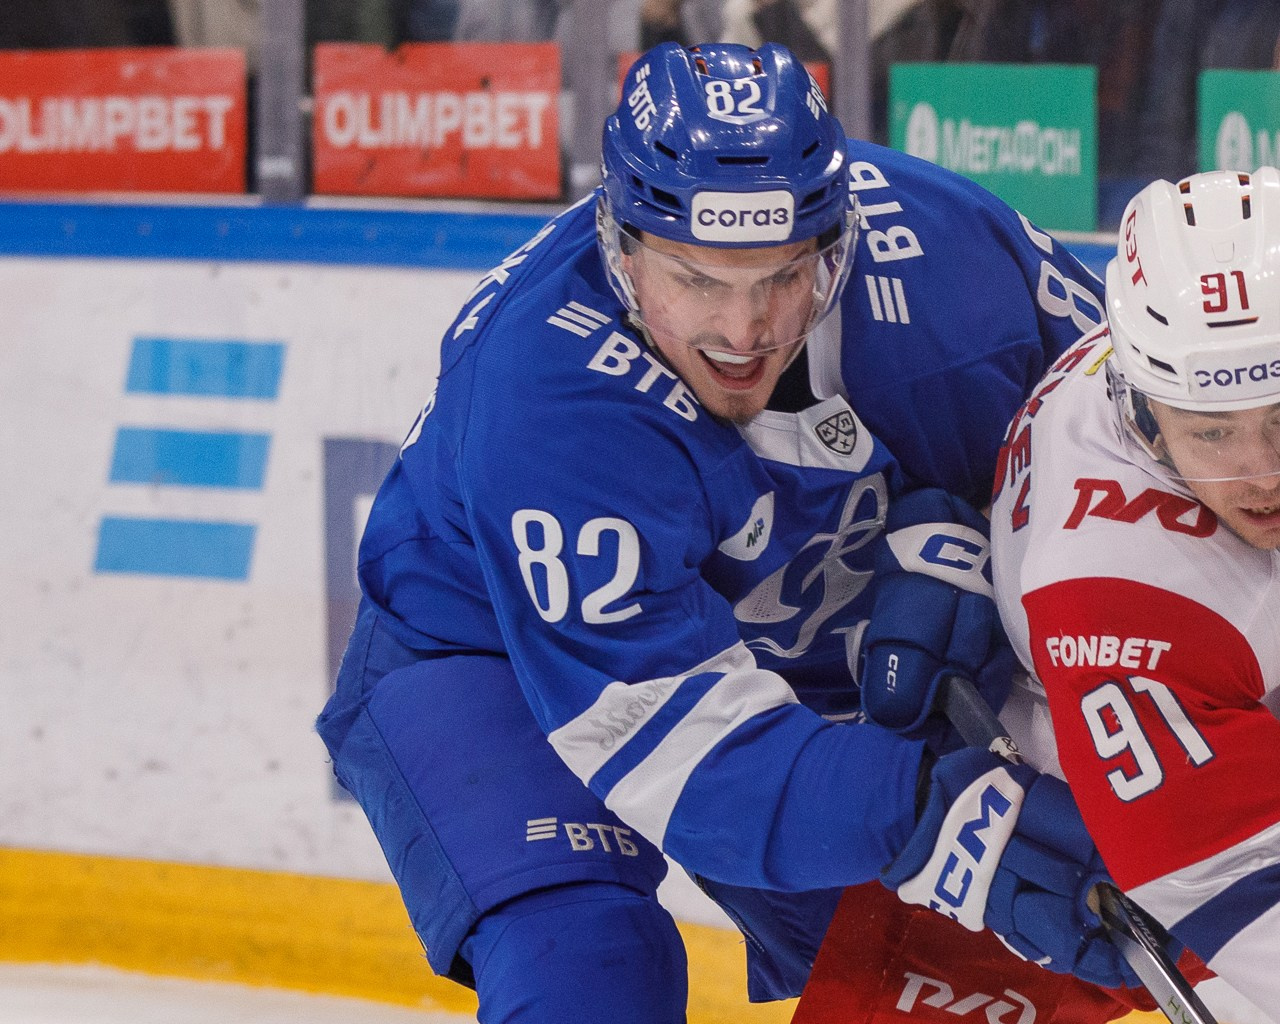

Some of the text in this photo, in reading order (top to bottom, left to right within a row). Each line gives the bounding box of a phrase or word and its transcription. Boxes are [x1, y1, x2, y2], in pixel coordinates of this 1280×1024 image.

[324, 91, 550, 148] OLIMPBET
[704, 80, 766, 117] 82
[697, 207, 790, 229] согаз
[1200, 270, 1251, 314] 91
[586, 330, 701, 423] ВТБ
[510, 508, 644, 625] 82
[1045, 634, 1173, 671] FONBET
[1080, 675, 1217, 803] 91
[564, 822, 640, 857] ВТБ
